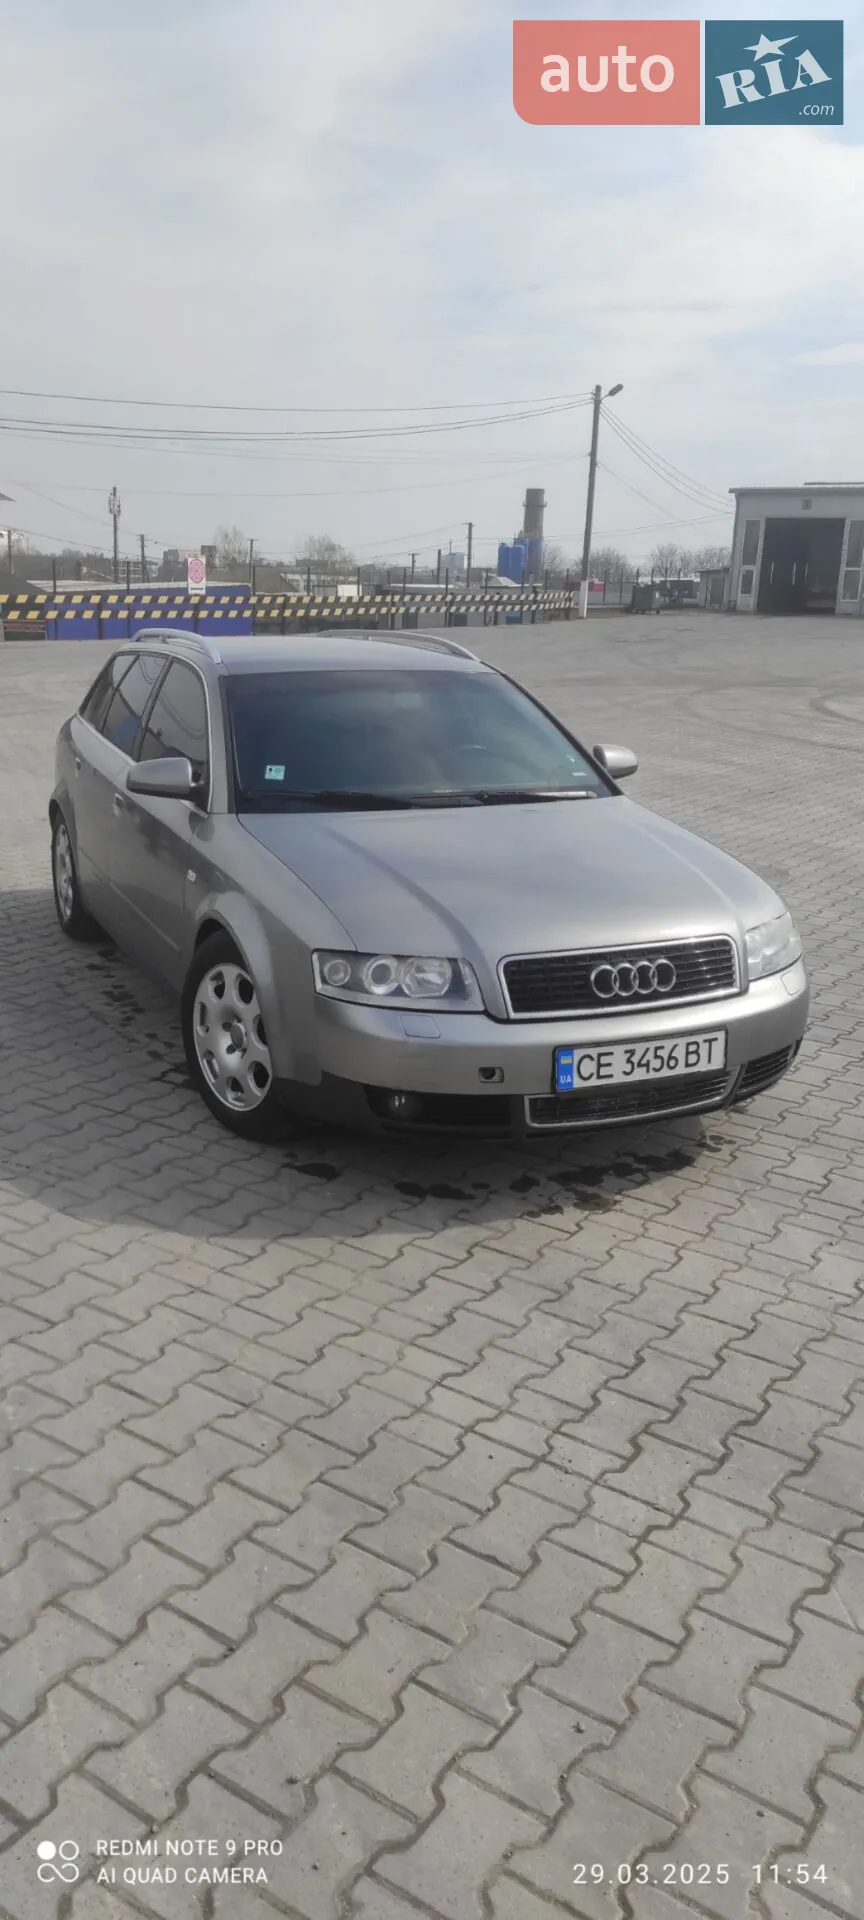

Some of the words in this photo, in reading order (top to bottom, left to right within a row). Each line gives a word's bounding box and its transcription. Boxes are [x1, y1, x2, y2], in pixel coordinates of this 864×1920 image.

[577, 1052, 614, 1081] CE
[622, 1044, 679, 1076] 3456
[684, 1037, 719, 1068] BT
[560, 1074, 572, 1084] UA
